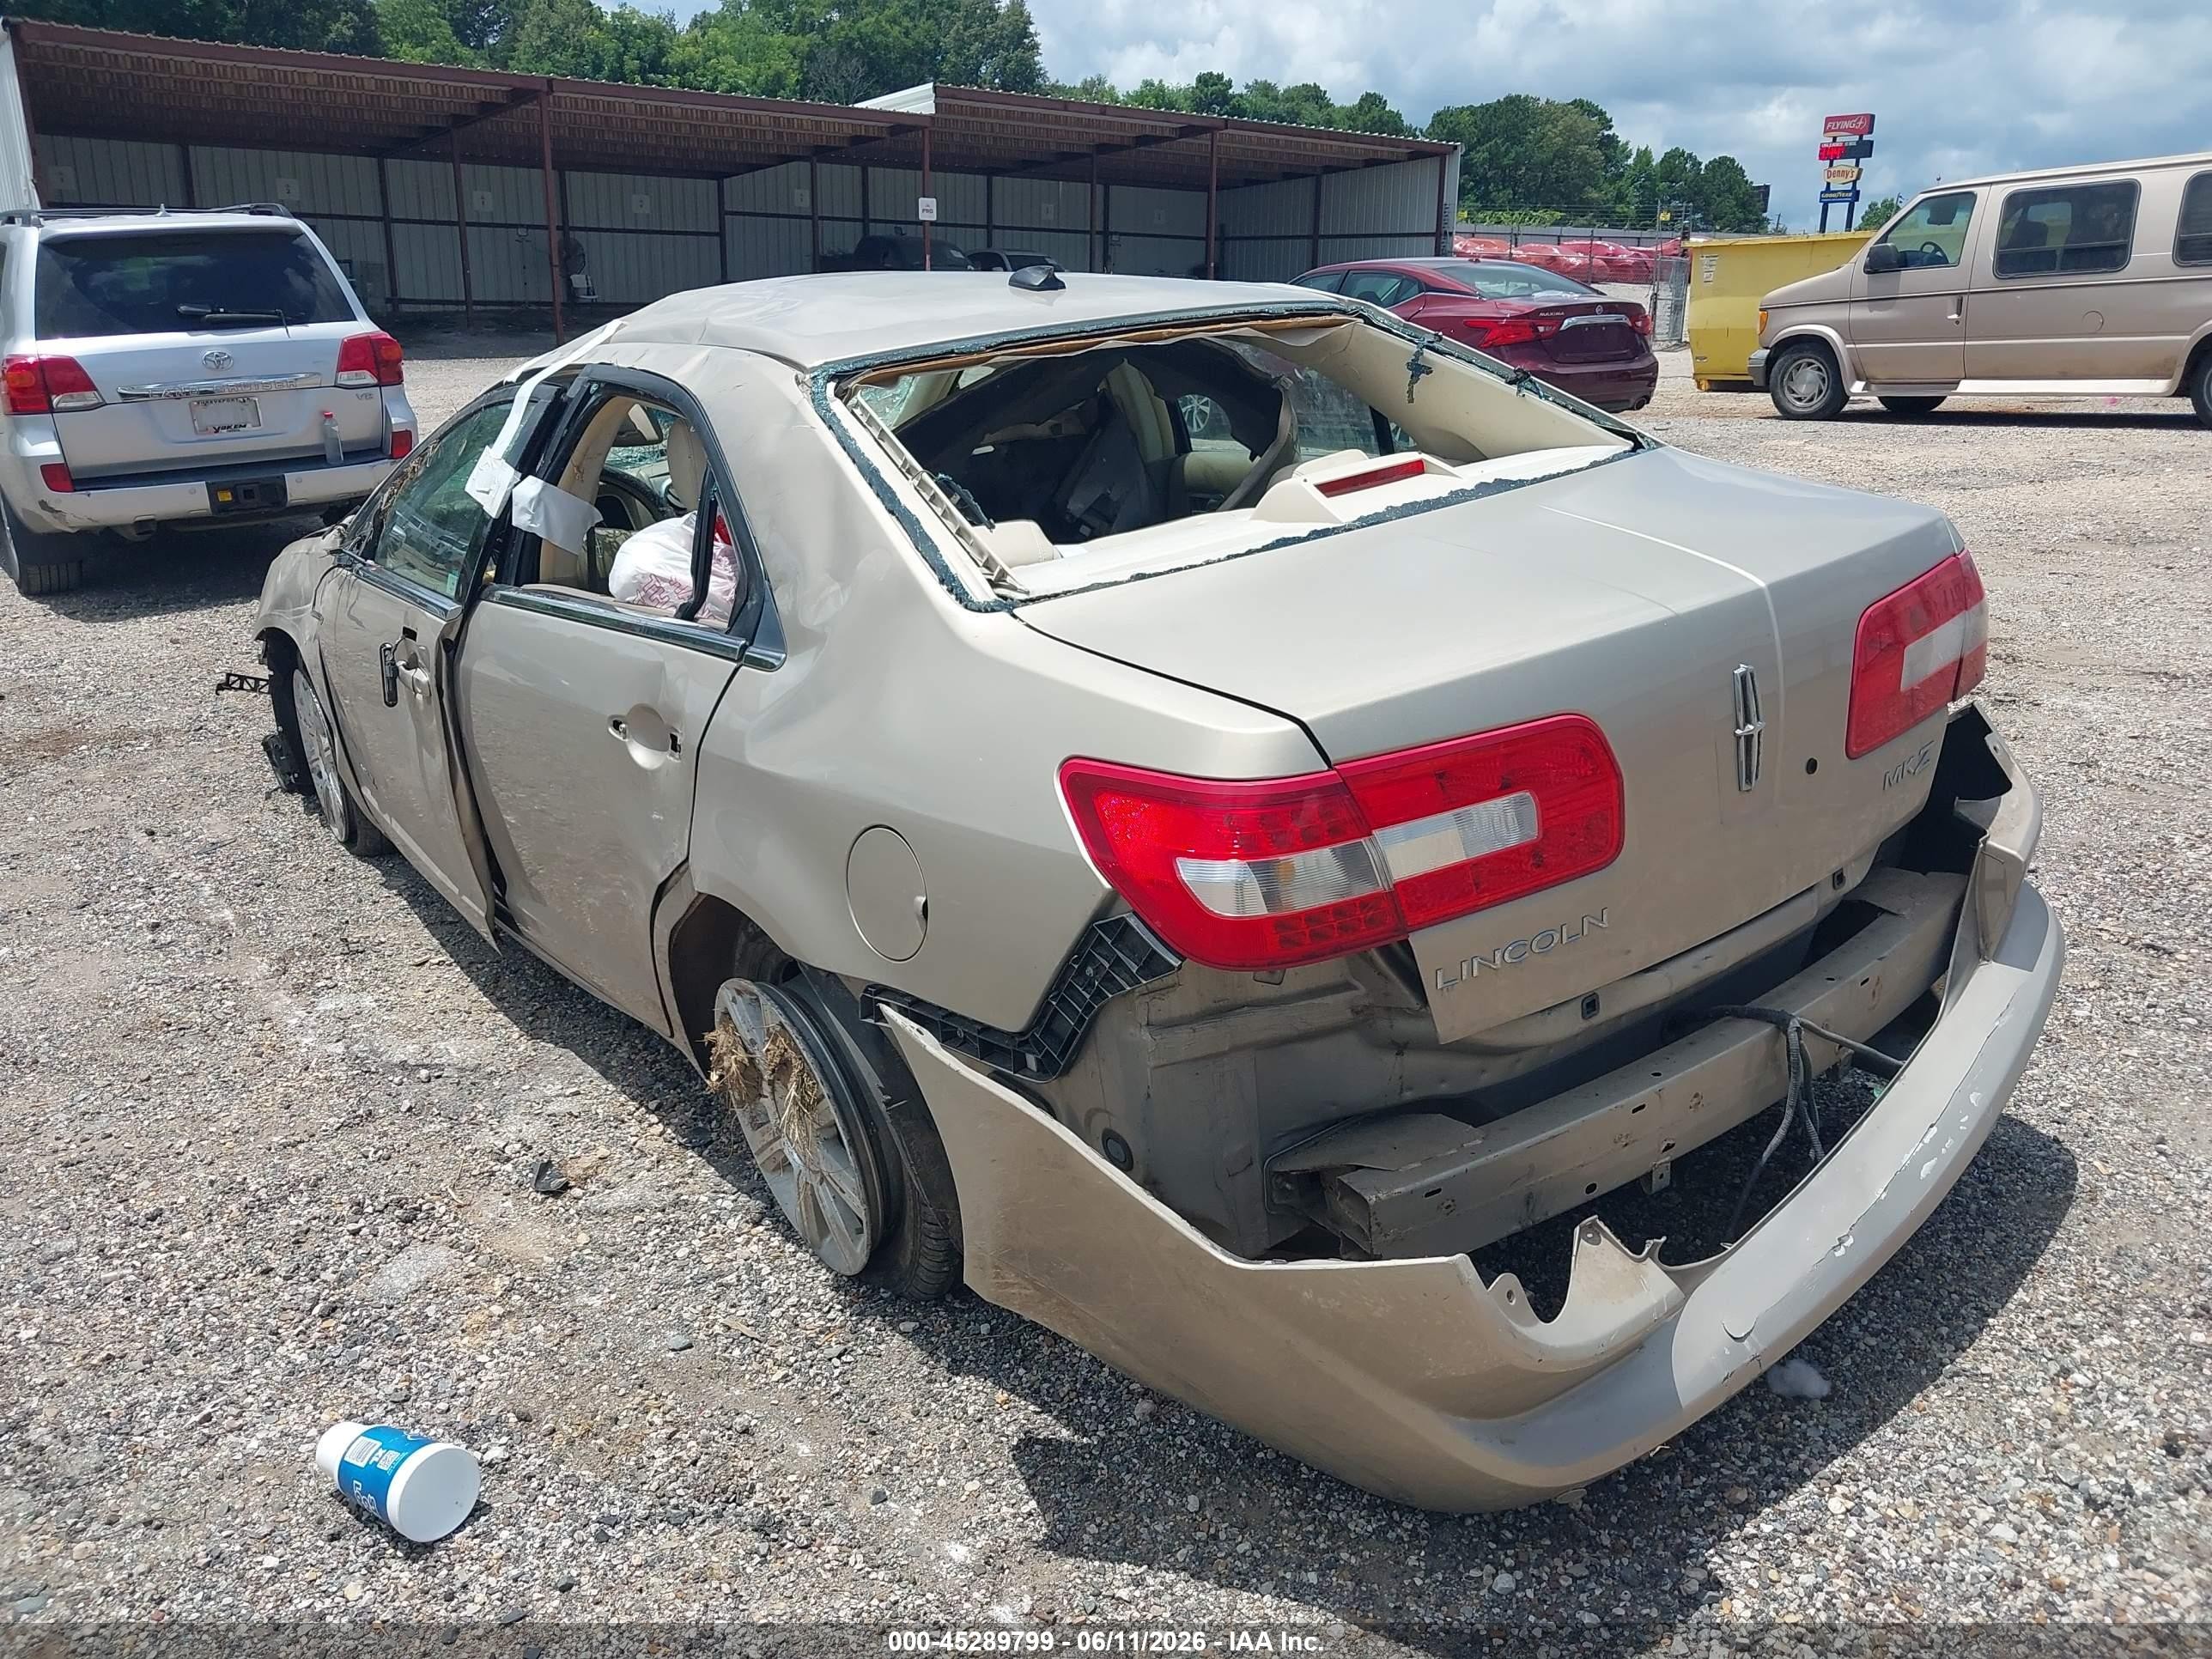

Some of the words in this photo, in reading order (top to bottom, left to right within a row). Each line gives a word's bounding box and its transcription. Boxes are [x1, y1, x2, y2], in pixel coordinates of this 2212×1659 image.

[1826, 119, 1856, 131] FLYING
[1826, 168, 1855, 179] Denny's
[149, 386, 199, 399] LAND
[214, 380, 297, 393] CRUISER
[1882, 740, 1935, 791] MKZ
[1436, 907, 1608, 990] LINCOLN
